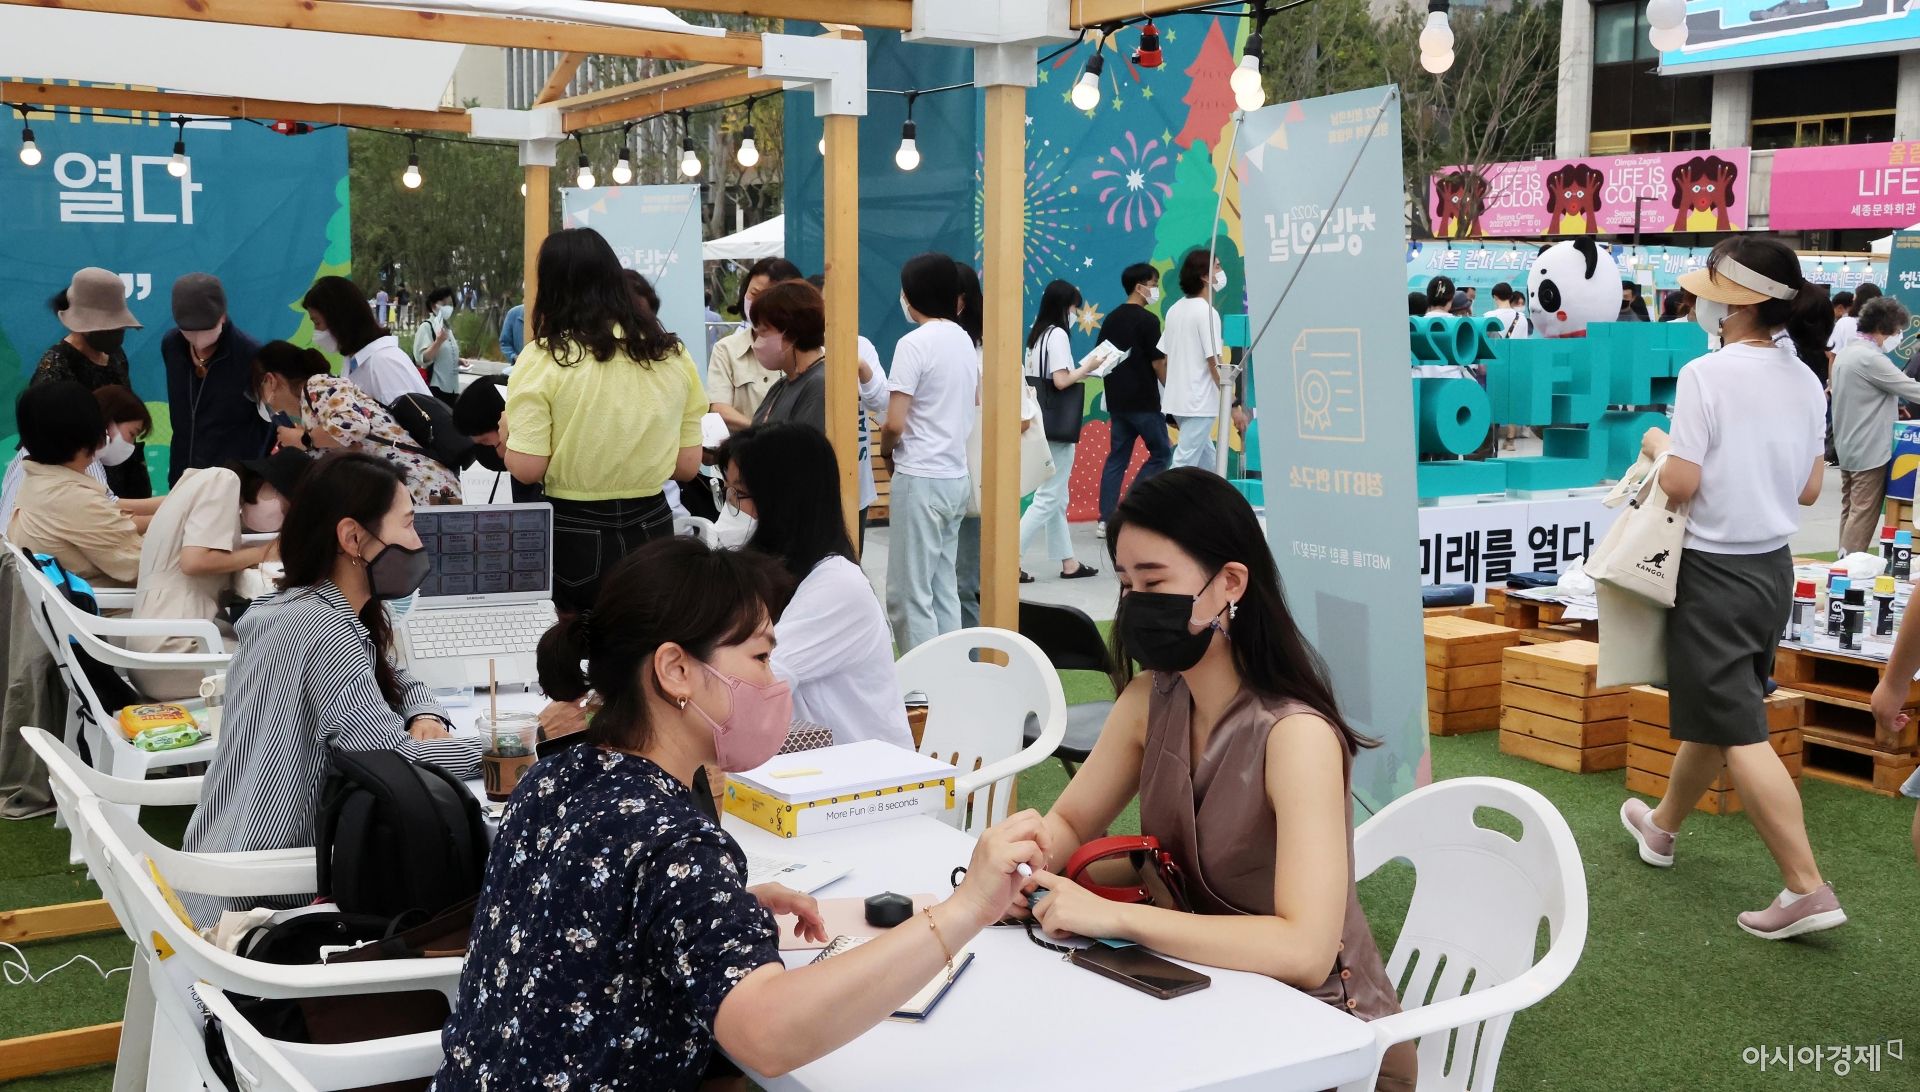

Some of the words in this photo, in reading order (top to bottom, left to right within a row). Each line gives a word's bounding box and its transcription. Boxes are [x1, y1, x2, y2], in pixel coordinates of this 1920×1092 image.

[1492, 174, 1523, 192] LIFE
[1526, 172, 1541, 191] IS
[1609, 167, 1644, 186] LIFE
[1648, 166, 1665, 185] IS
[1859, 167, 1920, 196] LIFE
[53, 151, 203, 225] 열다
[1605, 183, 1668, 204] COLOR
[1488, 190, 1544, 209] COLOR
[1850, 202, 1917, 217] 세종문화회관
[1426, 249, 1462, 270] 서울
[1419, 528, 1517, 585] 미래를
[1527, 521, 1595, 575] 열다
[826, 807, 848, 821] More
[849, 805, 866, 817] Fun
[868, 803, 877, 813] @
[877, 802, 885, 812] 8
[885, 796, 919, 811] seconds
